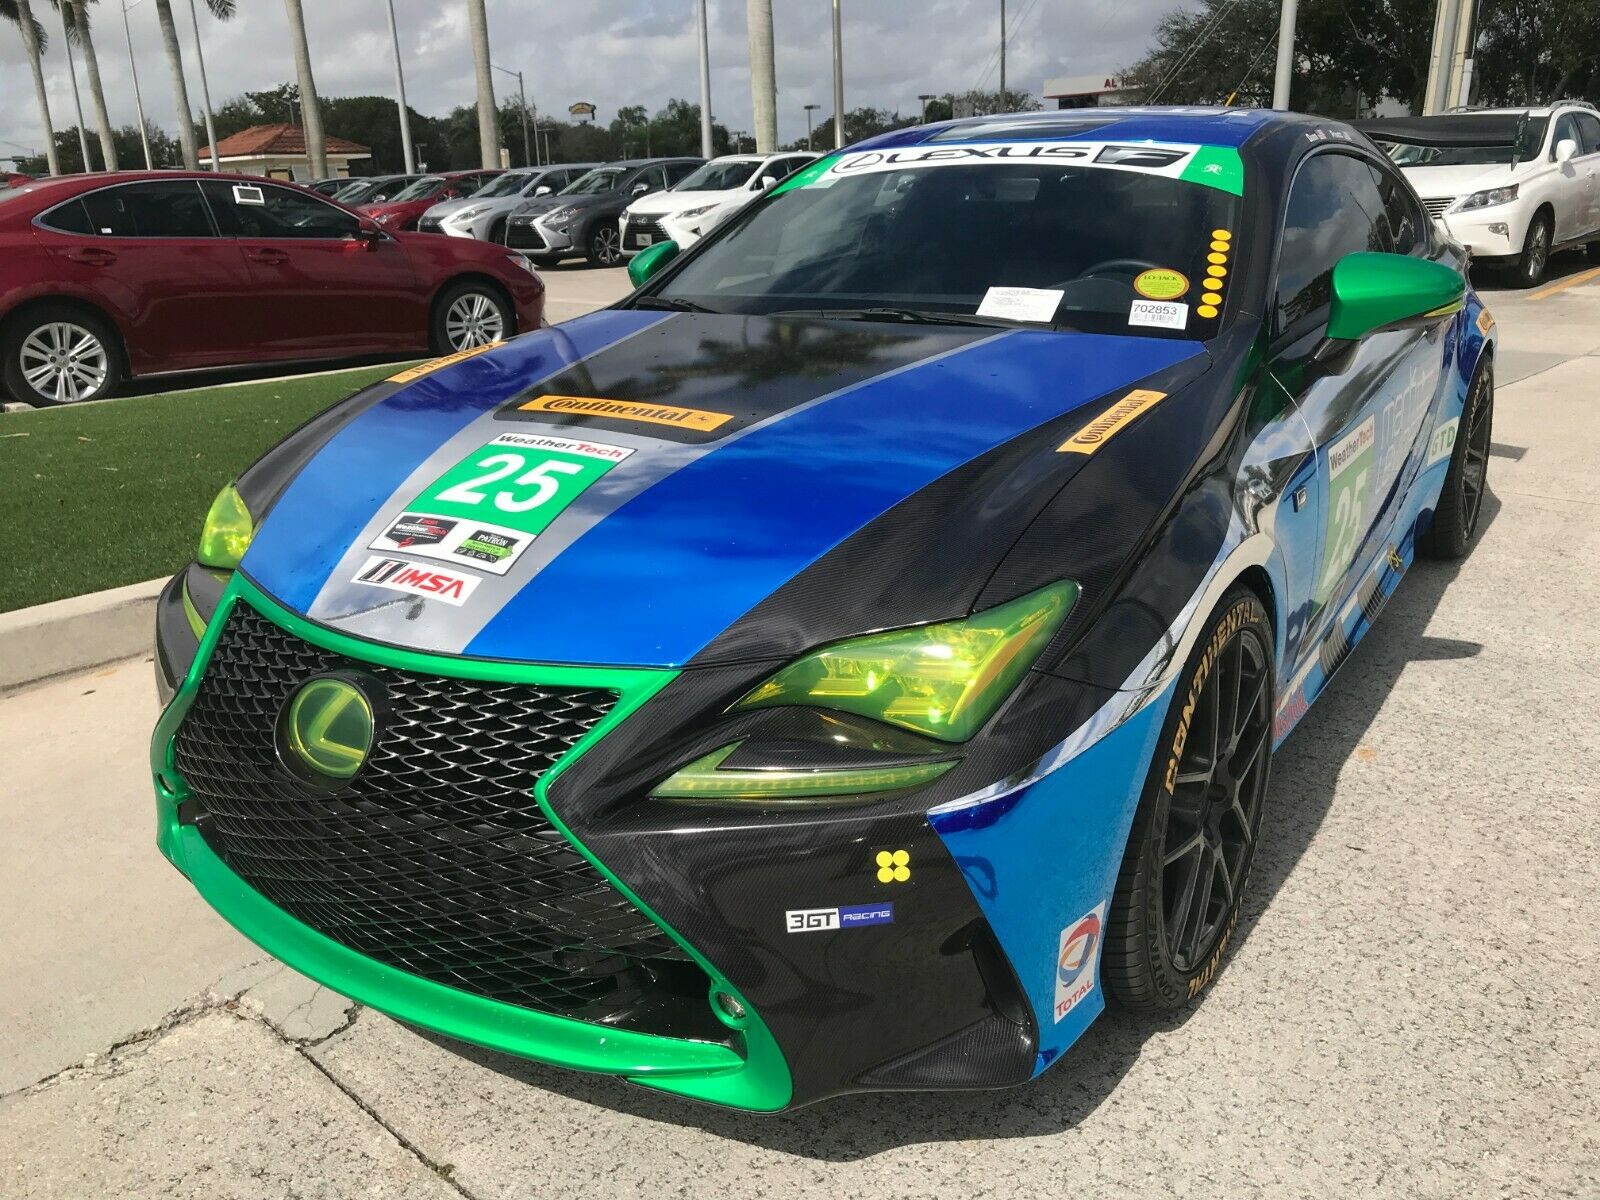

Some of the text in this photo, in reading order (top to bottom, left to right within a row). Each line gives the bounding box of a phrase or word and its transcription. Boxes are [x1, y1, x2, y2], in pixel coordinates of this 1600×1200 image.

[885, 145, 1089, 163] LEXUS
[1133, 303, 1178, 316] 702853
[543, 397, 692, 423] Continental
[1071, 398, 1148, 445] Continental
[499, 434, 622, 459] WeatherTech
[1329, 424, 1373, 472] WeatherTech
[433, 453, 585, 513] 25
[1321, 467, 1367, 590] 25
[391, 567, 465, 599] IMSA
[790, 911, 837, 930] 3GT
[1055, 979, 1094, 1017] TOTAL
